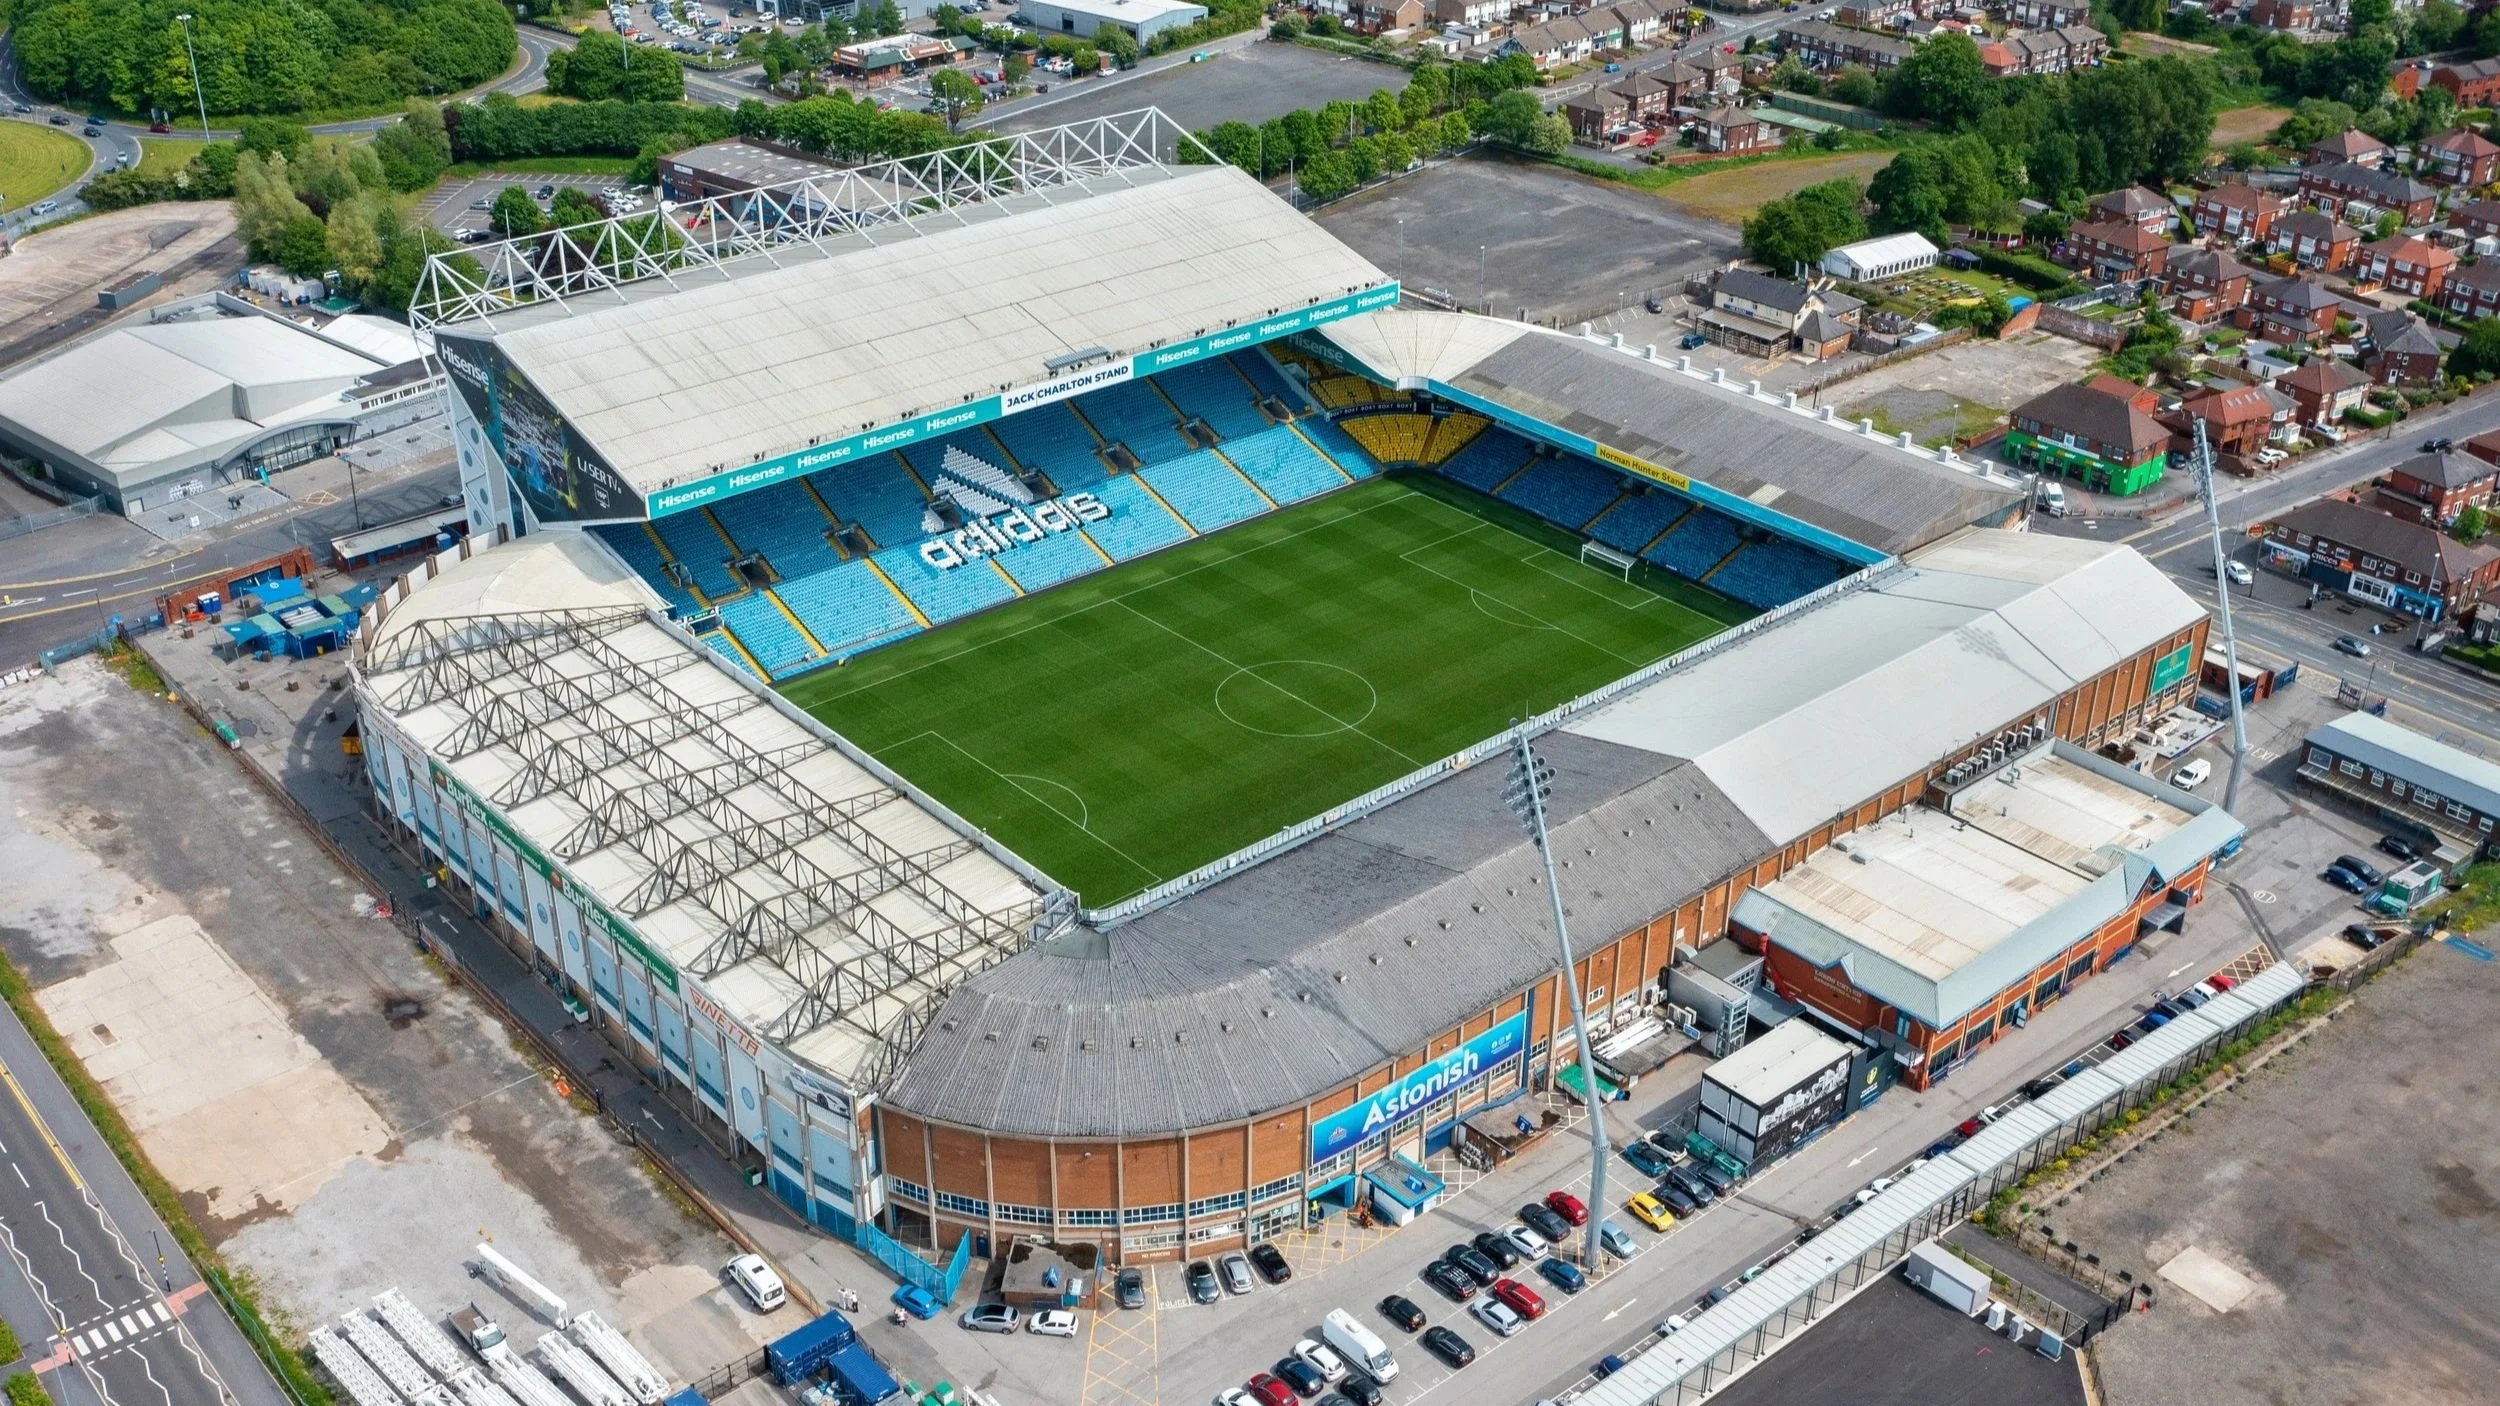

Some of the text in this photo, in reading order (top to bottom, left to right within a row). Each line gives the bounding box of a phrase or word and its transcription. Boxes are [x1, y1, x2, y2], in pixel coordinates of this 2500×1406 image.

[1357, 289, 1396, 309] Hisense
[1309, 303, 1349, 322] Hisense
[1259, 317, 1300, 336] Hisense
[1208, 331, 1251, 351] Hisense
[1288, 333, 1344, 363] Hisense
[441, 342, 490, 386] Hisense
[1155, 346, 1200, 366] Hisense
[1007, 365, 1129, 408] JACK CHARLTON STAND
[926, 409, 977, 432] Hisense
[863, 428, 915, 450] Hisense
[797, 446, 851, 469] Hisense
[1600, 448, 1686, 489] Norman Hunter Stand
[729, 465, 785, 488] Hisense
[658, 486, 716, 509] Hisense
[920, 492, 1109, 571] adidas
[445, 776, 488, 826] Burflex
[562, 877, 610, 933] Burflex
[689, 986, 760, 1056] GINETTA
[1362, 1049, 1478, 1133] Astonish
